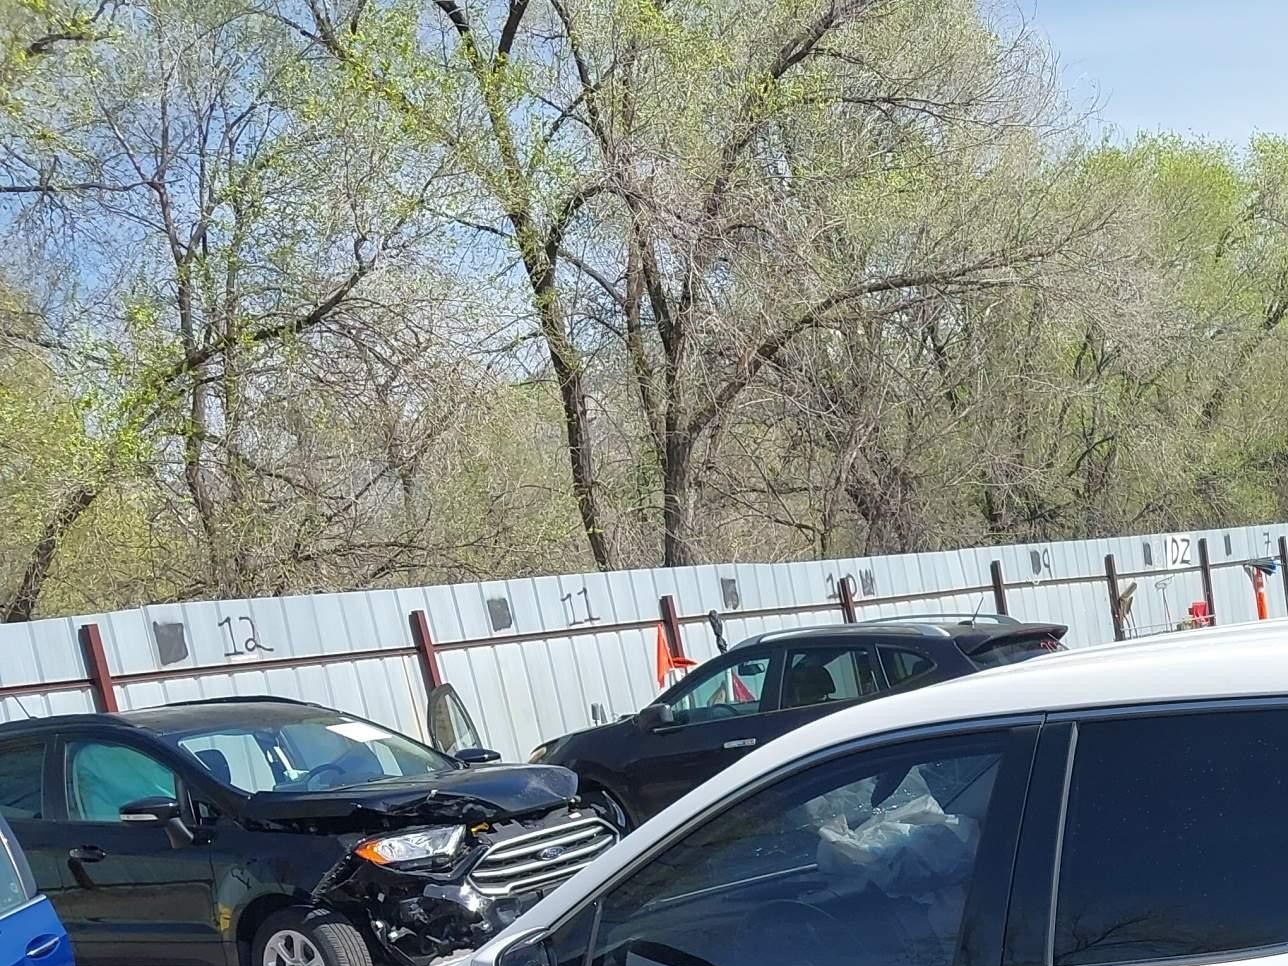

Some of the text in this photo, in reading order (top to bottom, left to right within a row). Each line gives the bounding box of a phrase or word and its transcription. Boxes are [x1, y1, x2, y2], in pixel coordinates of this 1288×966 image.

[1263, 531, 1272, 557] 7
[560, 587, 601, 626] 11
[218, 616, 274, 656] 12
